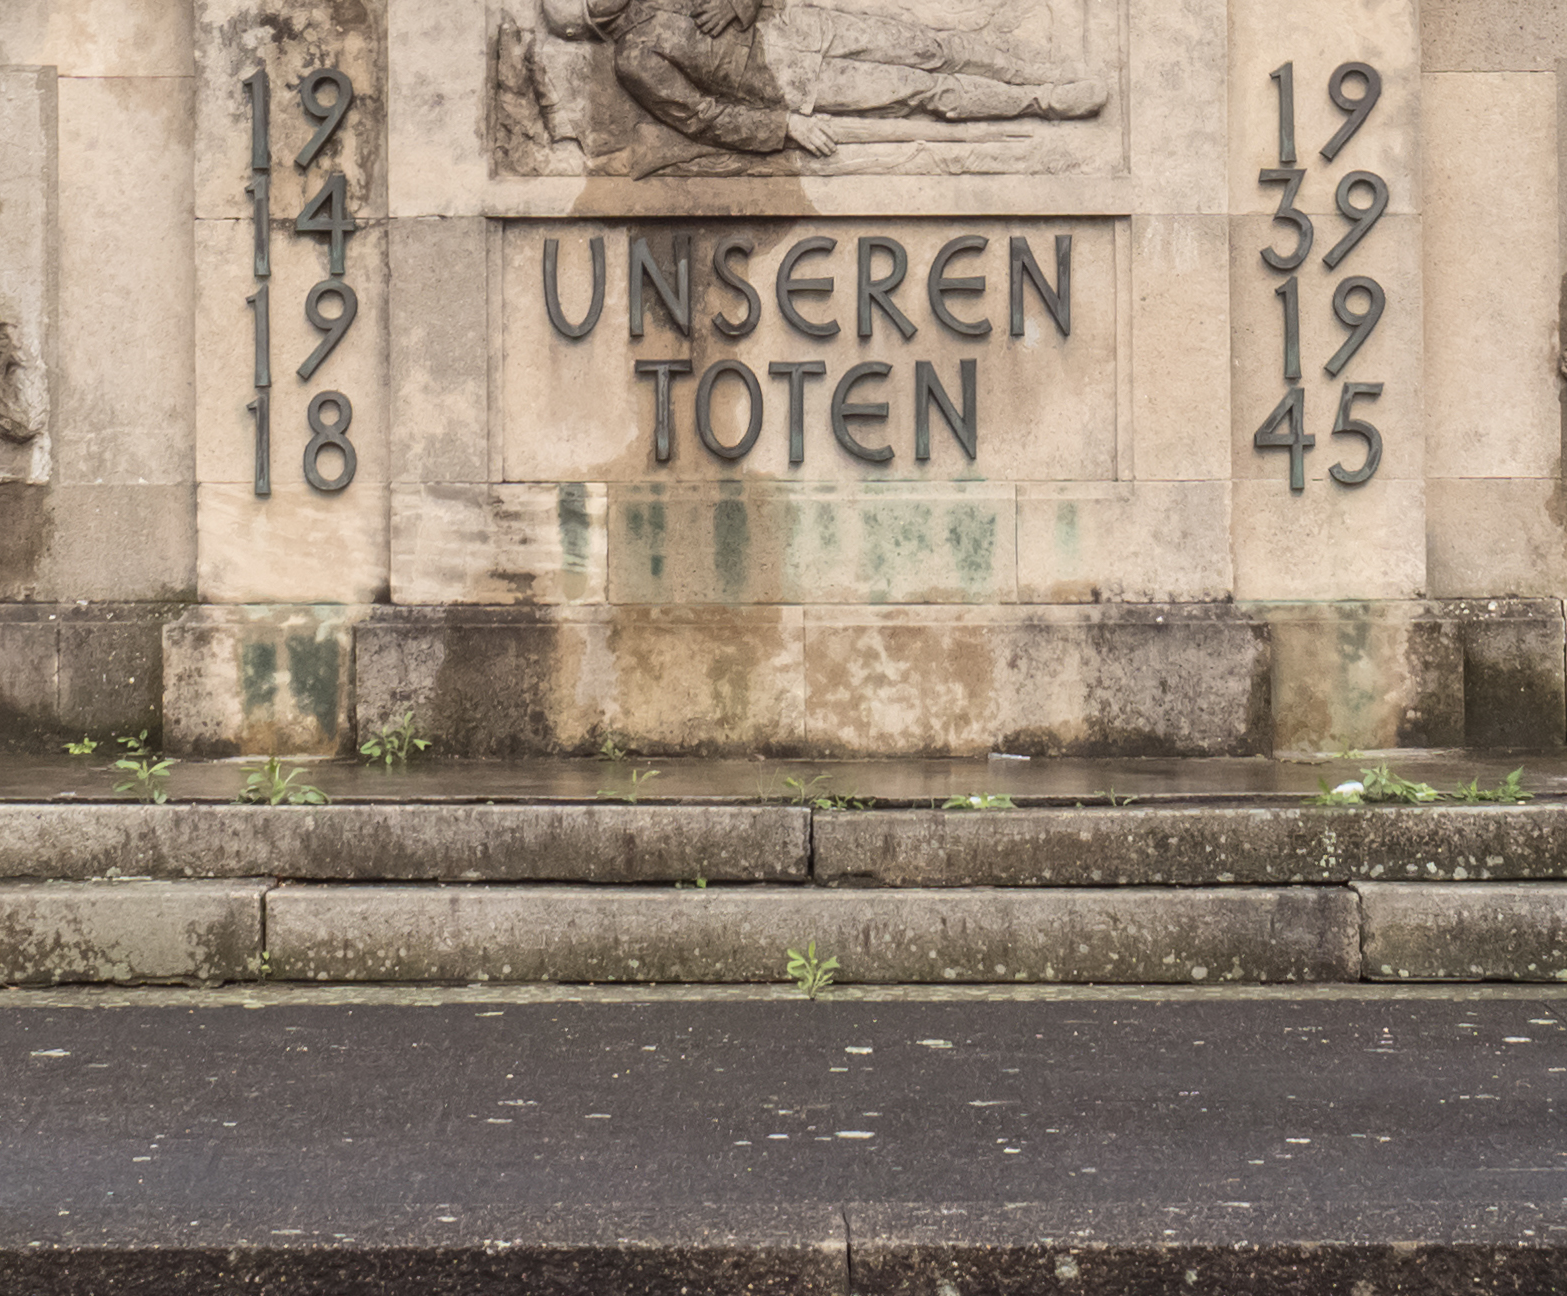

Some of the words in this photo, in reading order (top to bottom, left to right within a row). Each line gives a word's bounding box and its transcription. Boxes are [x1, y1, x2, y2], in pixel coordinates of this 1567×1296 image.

[243, 66, 354, 170] 19
[1268, 60, 1383, 164] 19
[244, 172, 356, 277] 14
[1257, 168, 1389, 272] 39
[245, 279, 358, 388] 19
[542, 234, 1072, 340] UNSEREN
[1274, 274, 1387, 380] 19
[246, 389, 358, 495] 18
[634, 358, 978, 464] TOTEN
[1253, 381, 1385, 492] 45
